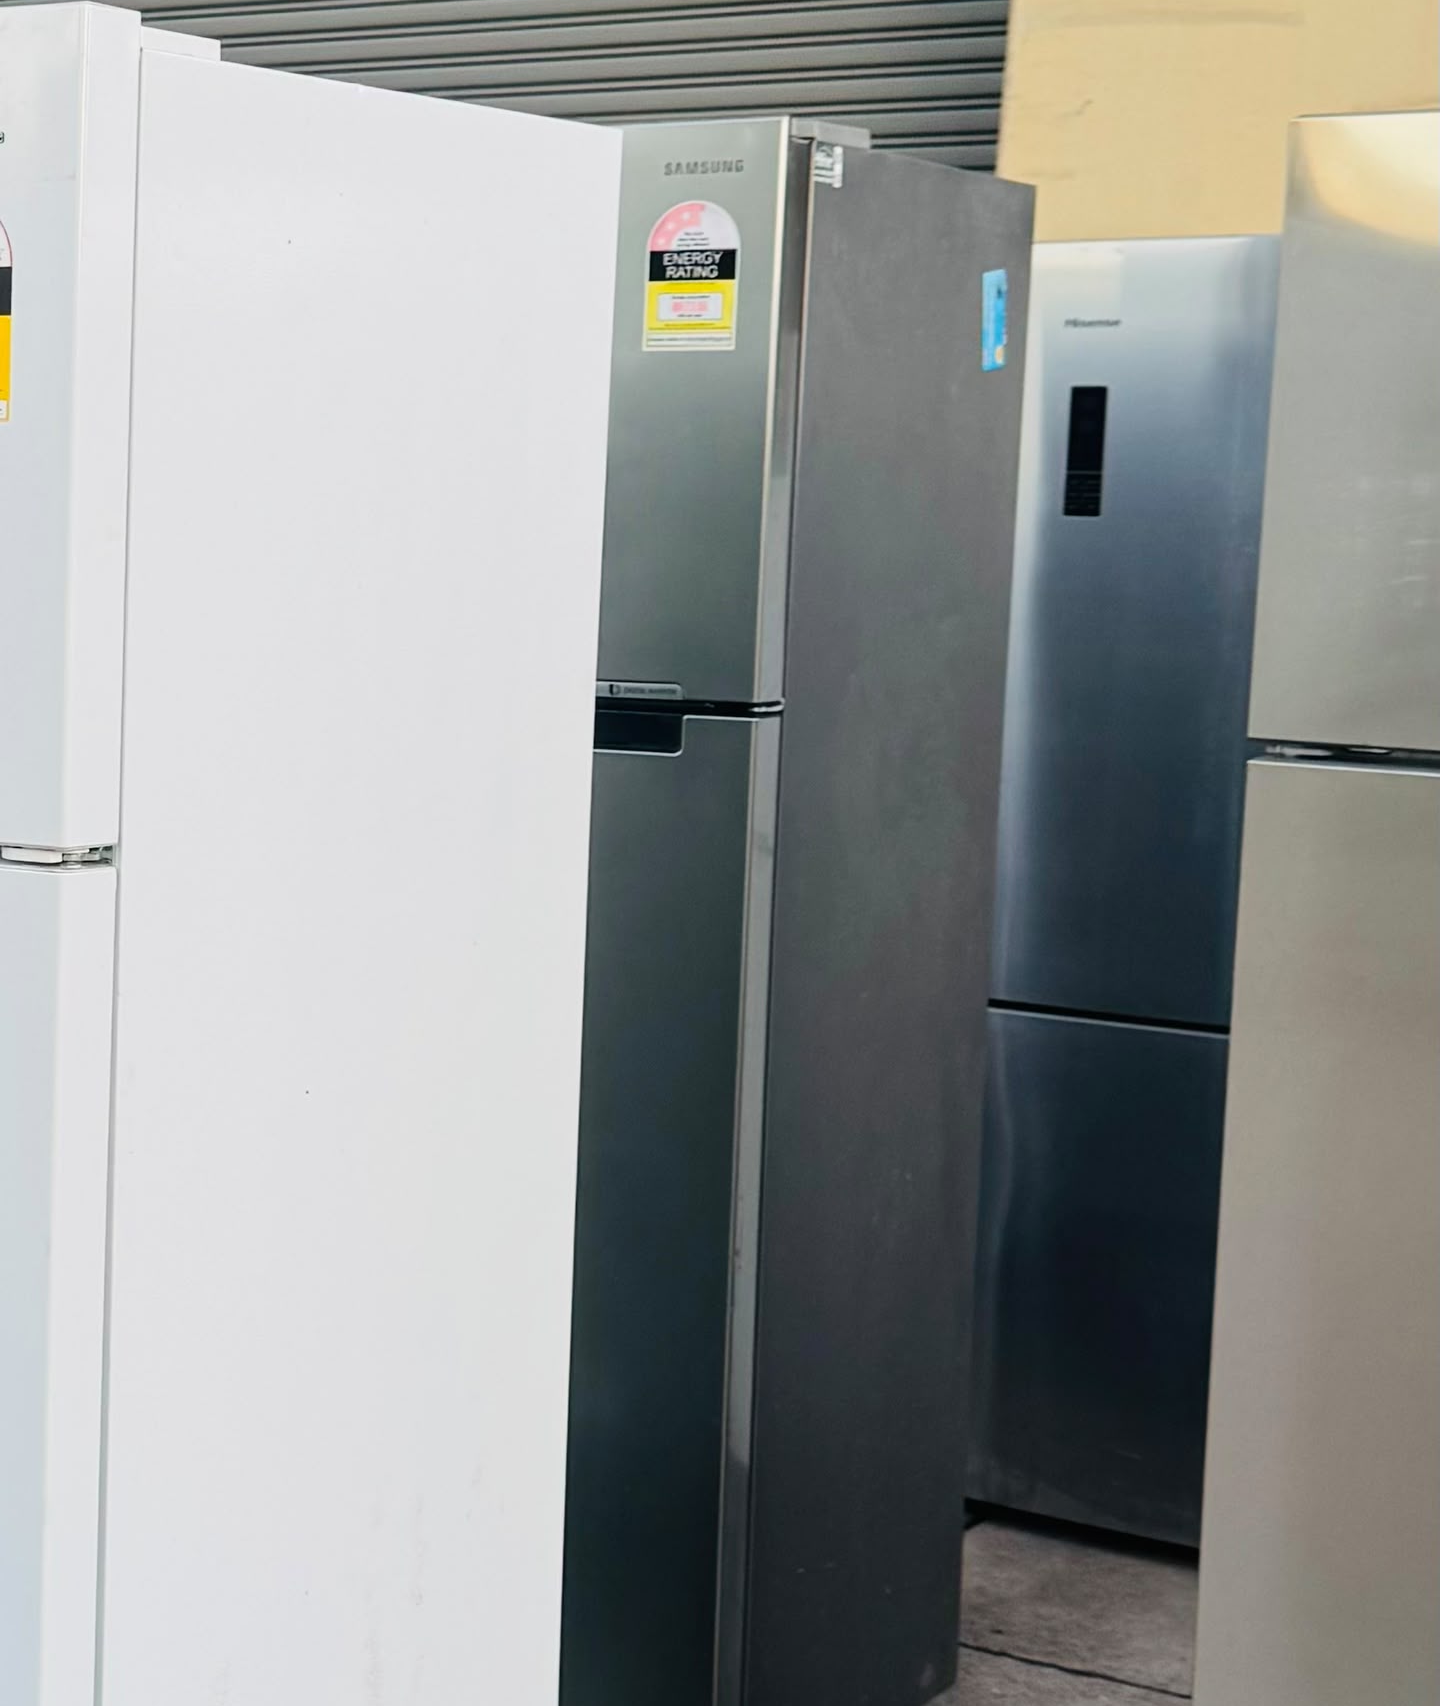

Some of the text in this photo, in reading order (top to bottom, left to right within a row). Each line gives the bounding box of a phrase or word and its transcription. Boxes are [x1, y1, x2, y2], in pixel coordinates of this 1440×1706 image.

[663, 159, 744, 176] SAMSUNG
[662, 251, 724, 266] ENERGY
[665, 264, 719, 279] RATING
